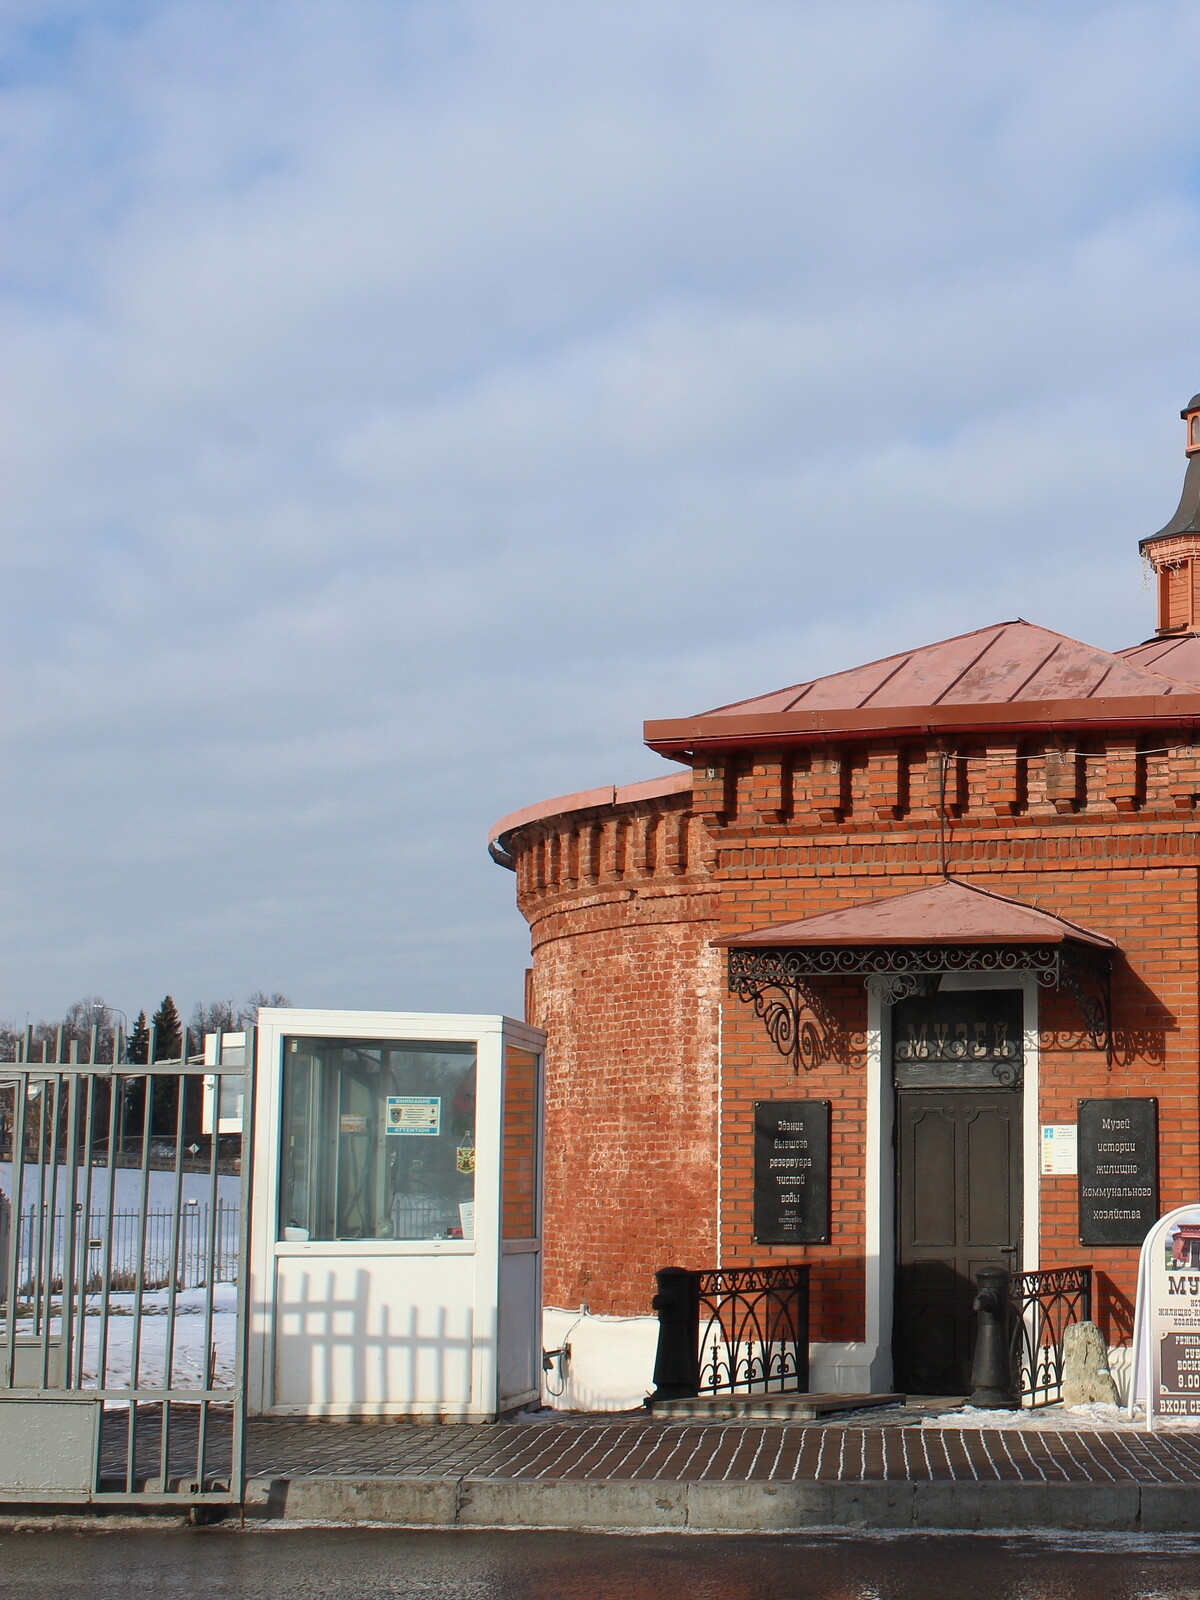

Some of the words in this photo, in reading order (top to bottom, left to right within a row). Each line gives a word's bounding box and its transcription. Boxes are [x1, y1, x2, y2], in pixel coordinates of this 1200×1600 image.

[907, 1022, 1008, 1057] МУЗЕЙ
[778, 1120, 804, 1131] Здание
[1102, 1119, 1130, 1131] Музей
[774, 1138, 808, 1149] бывшего
[1097, 1142, 1136, 1153] истории
[769, 1157, 812, 1169] резервуара
[776, 1174, 805, 1185] чистой
[781, 1192, 800, 1203] воды
[1082, 1186, 1152, 1199] коммунального
[1093, 1208, 1141, 1220] хозяйства
[1160, 1399, 1188, 1415] ВХОД
